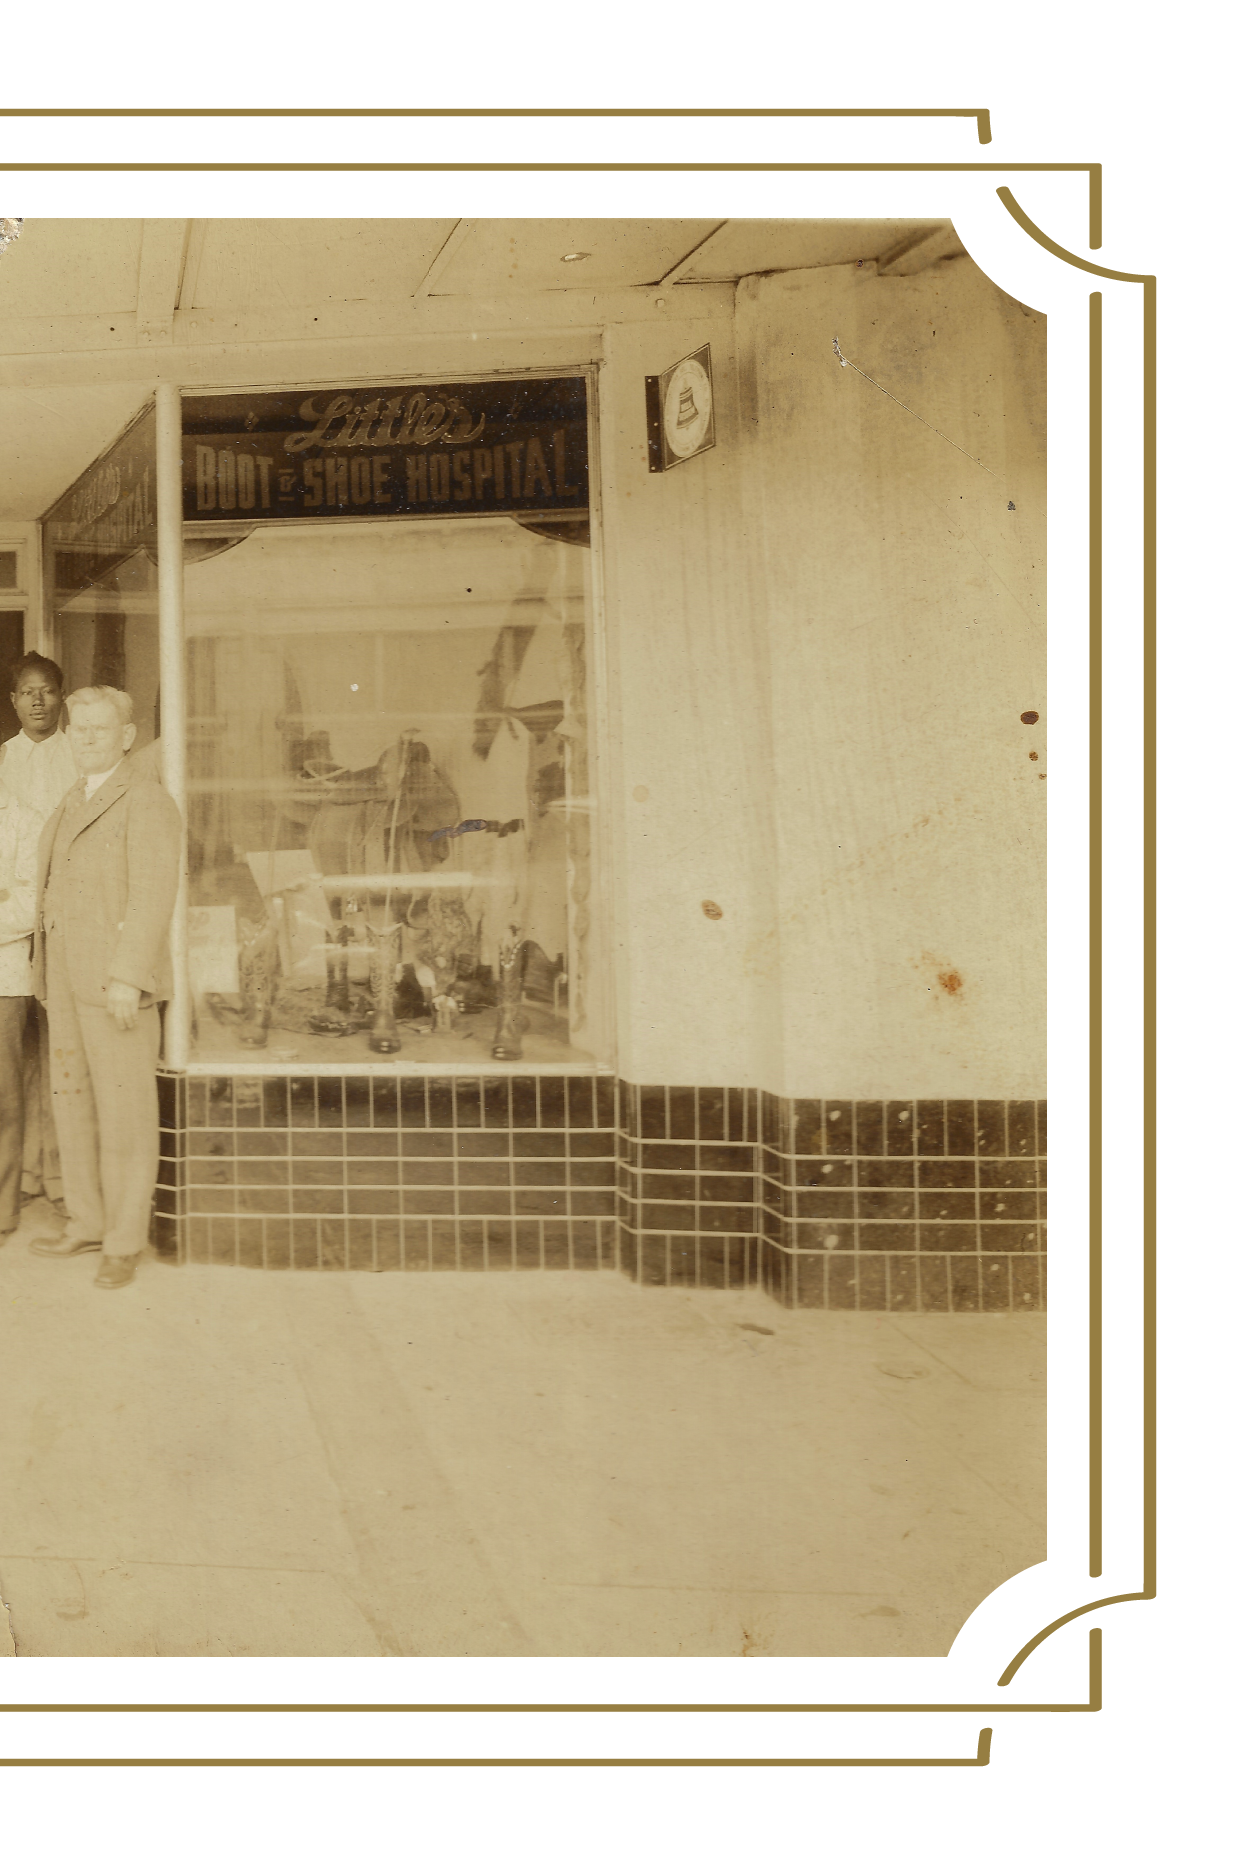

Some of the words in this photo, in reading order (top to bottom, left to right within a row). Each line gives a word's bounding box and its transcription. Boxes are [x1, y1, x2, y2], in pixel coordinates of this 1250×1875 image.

[284, 392, 485, 452] Little's
[195, 444, 273, 511] BOOT
[303, 454, 392, 507] SHOE
[406, 429, 579, 504] HOSPITAL
